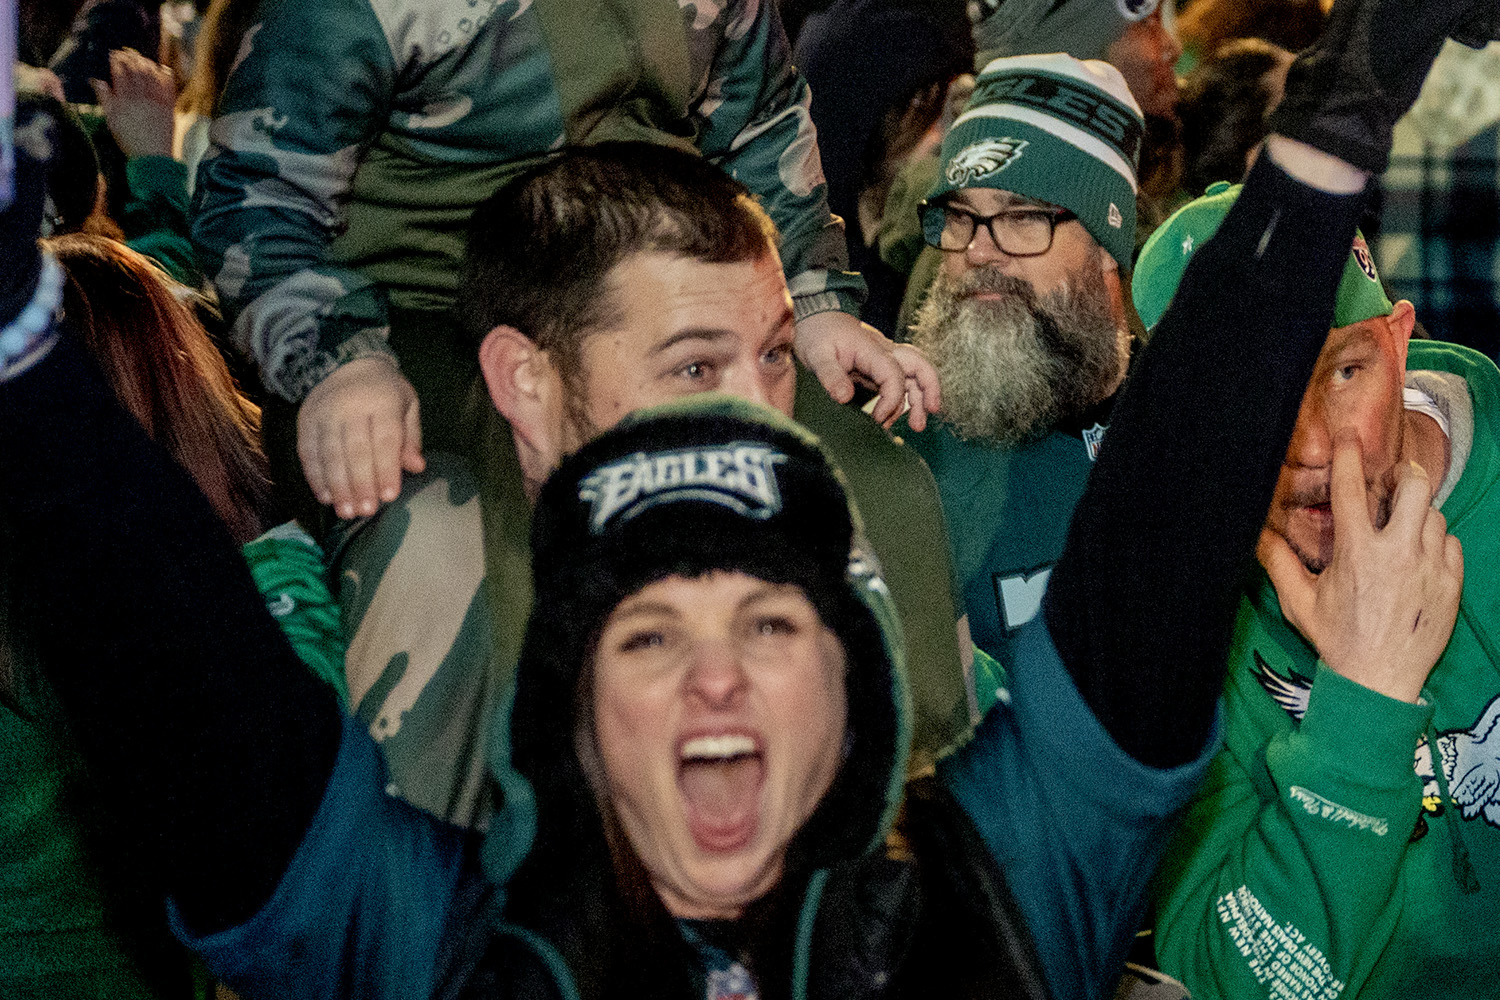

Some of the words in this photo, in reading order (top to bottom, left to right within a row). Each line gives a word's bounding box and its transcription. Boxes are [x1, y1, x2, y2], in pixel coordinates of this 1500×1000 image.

[577, 442, 789, 536] EAGLES
[1216, 895, 1232, 923] NFL
[1228, 926, 1253, 958] NEW
[1260, 929, 1279, 953] THE
[1284, 921, 1306, 944] ACT.
[1275, 950, 1292, 965] OF
[1294, 950, 1316, 971] NEW
[1248, 958, 1267, 985] THE
[1270, 959, 1304, 994] NAMED
[1289, 961, 1321, 995] HONOR
[1311, 965, 1327, 988] THE
[1323, 986, 1339, 999] OF
